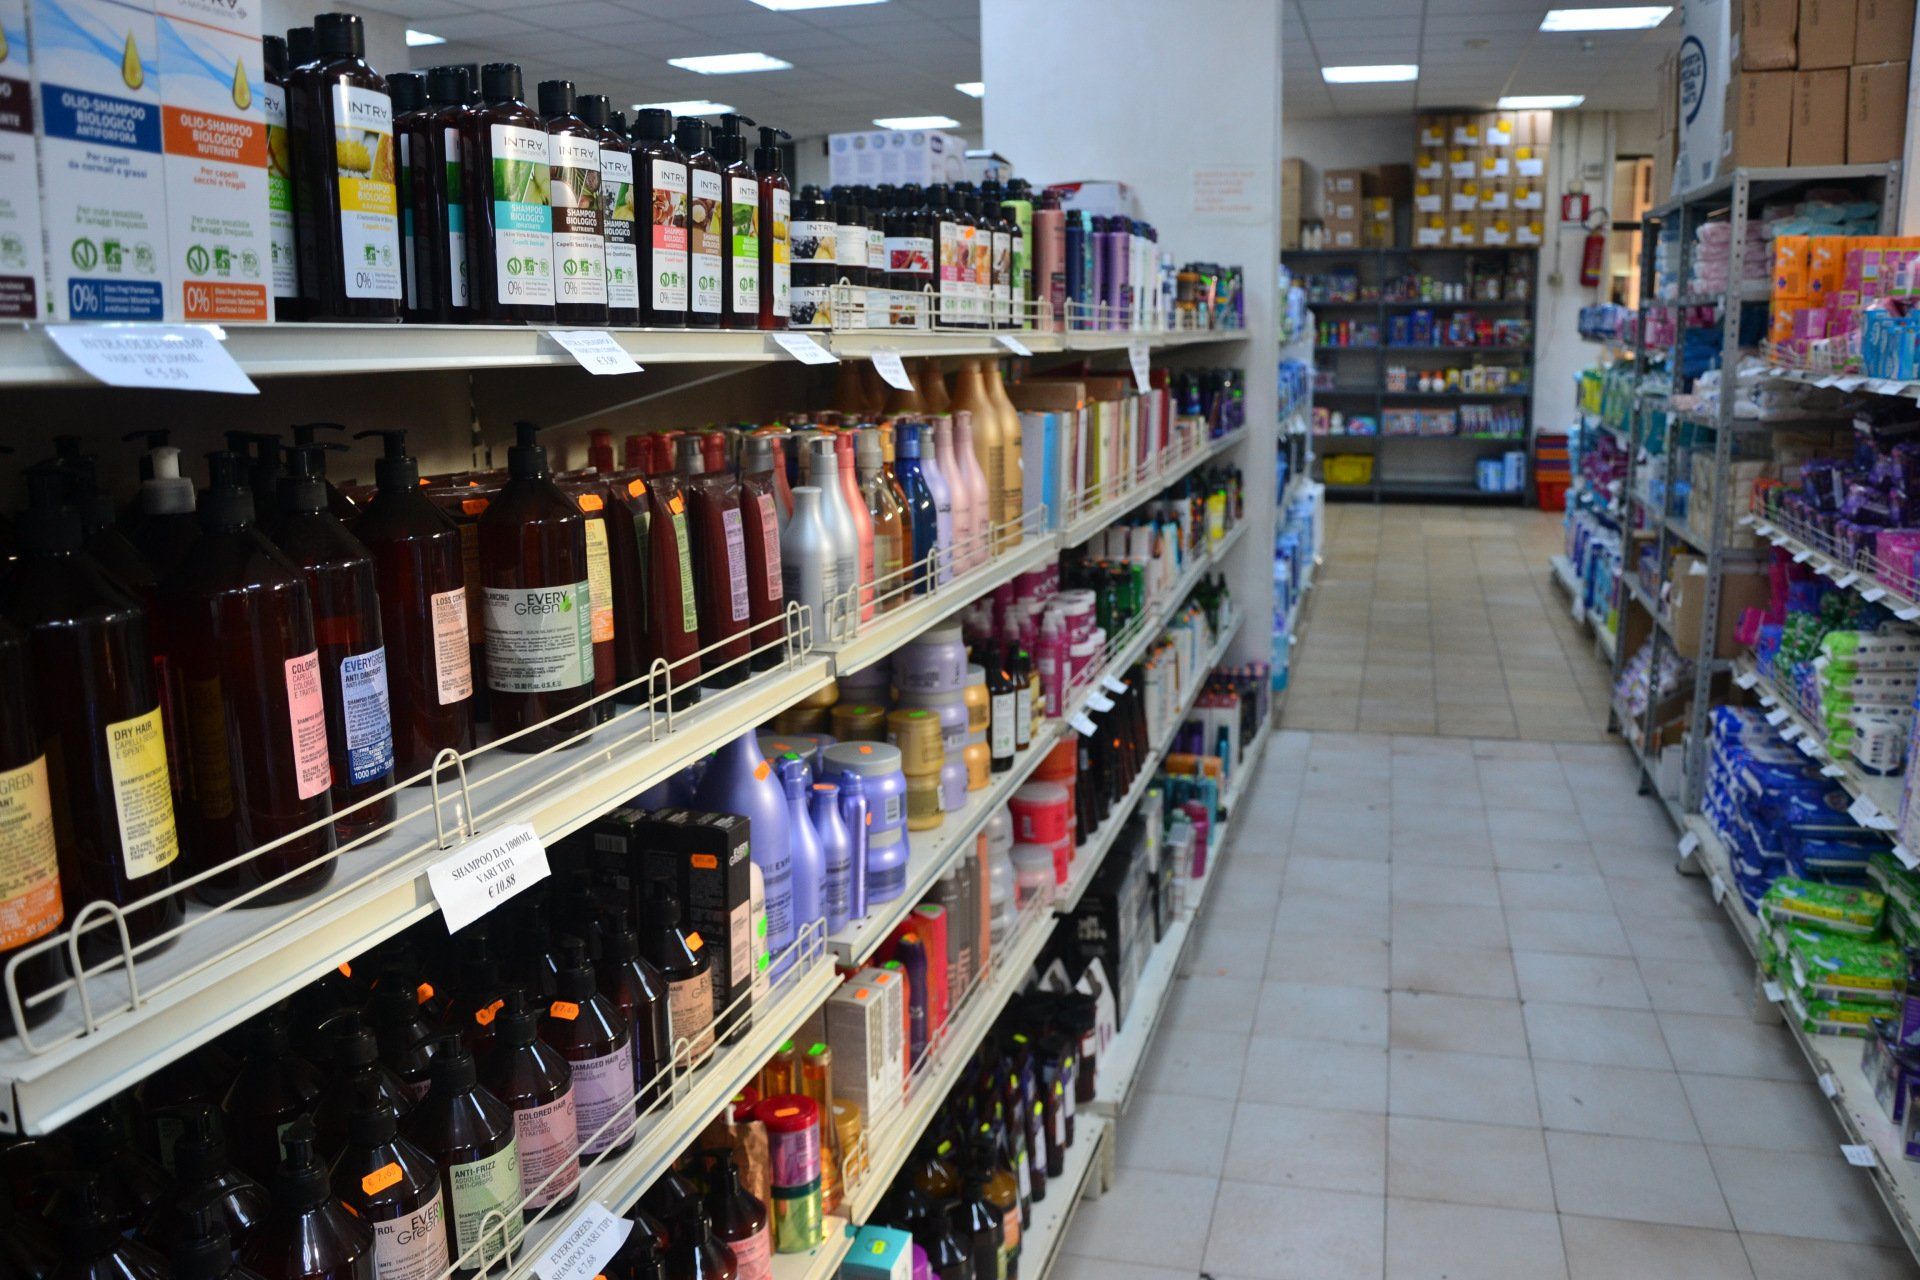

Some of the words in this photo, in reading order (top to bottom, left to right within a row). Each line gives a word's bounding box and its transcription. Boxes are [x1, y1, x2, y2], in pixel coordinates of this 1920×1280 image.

[62, 92, 146, 120] OLIO-SHAMPOO
[76, 110, 136, 132] BIOLOGICO
[180, 114, 253, 138] OLIO-SHAMPOO
[76, 125, 137, 144] ANTIFORFORA
[192, 129, 244, 149] BIOLOGICO
[198, 142, 240, 159] NUTRIENTE
[510, 212, 545, 224] BIOLOGICO
[511, 204, 543, 215] SHAMPOO
[566, 209, 596, 219] SHAMPOO
[566, 217, 597, 227] BIOLOGICO
[356, 271, 372, 289] 0%
[507, 280, 523, 296] 0%
[564, 281, 578, 296] 0%
[72, 283, 99, 313] 0%
[187, 287, 210, 313] 0%
[436, 596, 452, 606] LOSS
[526, 590, 568, 606] EVERY
[514, 602, 560, 616] Green
[345, 674, 359, 683] ANTI
[114, 727, 133, 742] DRY
[135, 720, 153, 735] HAIR
[354, 769, 370, 780] 1000
[451, 852, 493, 881] SHAMPOO
[492, 848, 506, 861] DA
[505, 831, 533, 853] 1000ML
[476, 866, 498, 884] VARI
[499, 857, 515, 874] TIPI
[488, 885, 495, 899] €
[495, 873, 516, 895] 10.88
[570, 1060, 604, 1071] DAMAGED
[604, 1055, 619, 1066] HAIR
[518, 1107, 552, 1121] COLORED
[553, 1099, 567, 1113] HAIR
[454, 1160, 496, 1179] ANTI-FRIZZ
[550, 1216, 595, 1265] EVERYGREEN
[551, 1246, 586, 1280] SHAMPOO
[582, 1230, 601, 1249] VARI
[597, 1216, 613, 1233] TIPI
[577, 1266, 585, 1275] €
